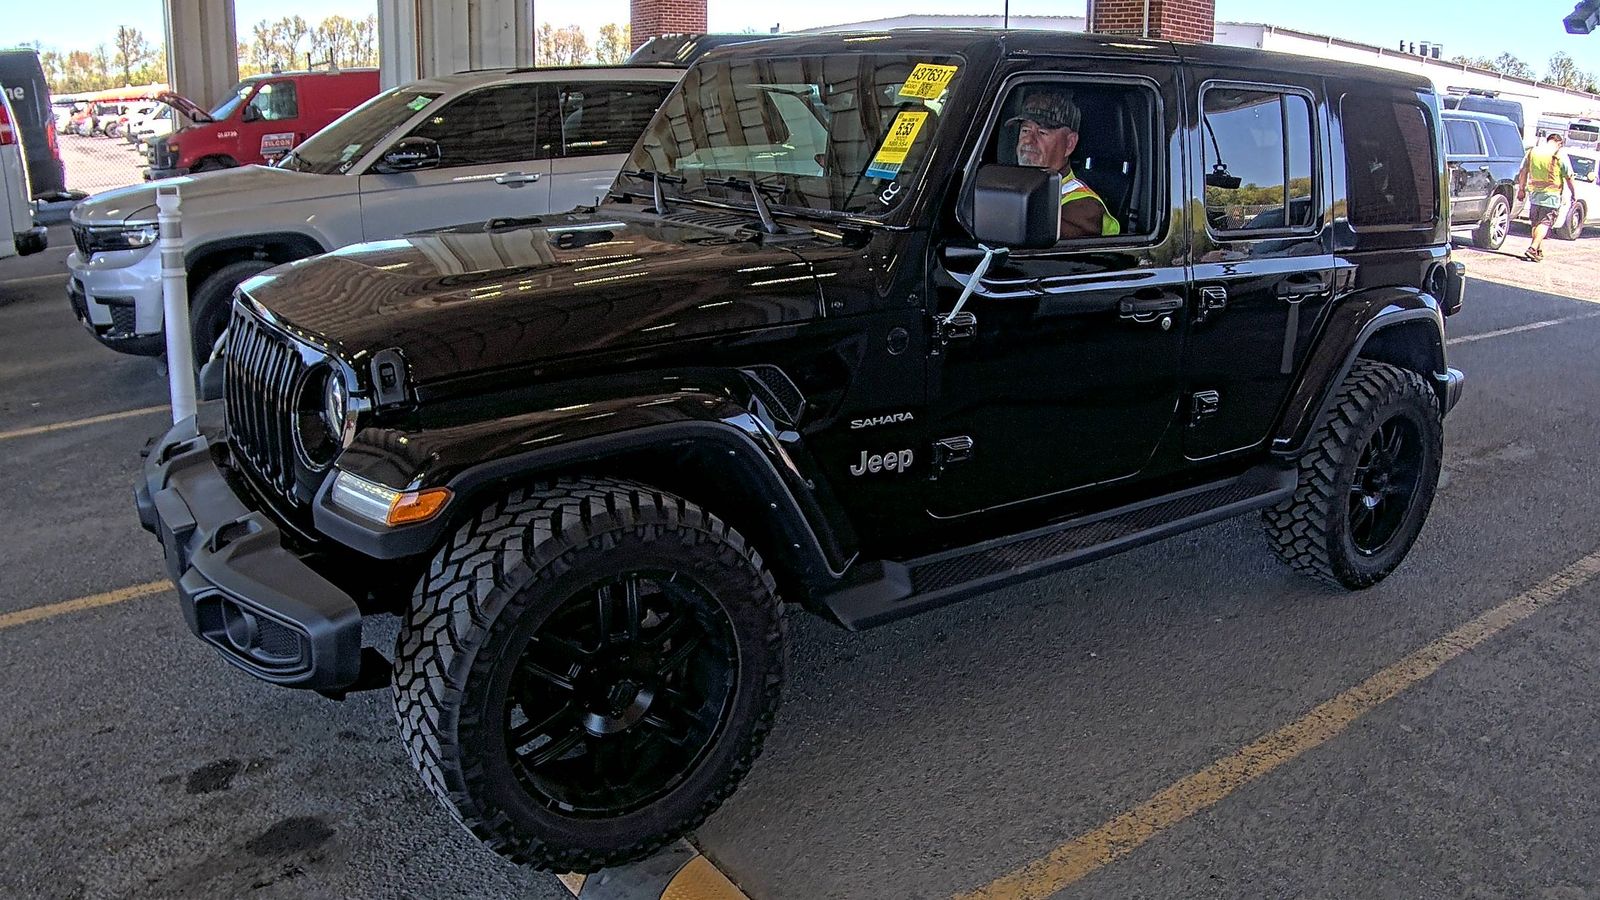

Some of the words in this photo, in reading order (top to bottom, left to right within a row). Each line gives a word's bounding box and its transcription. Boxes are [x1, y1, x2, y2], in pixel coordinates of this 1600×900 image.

[912, 67, 955, 82] 4376317
[264, 139, 291, 147] TILCON
[850, 412, 914, 429] SAHARA
[850, 449, 914, 476] Jeep
